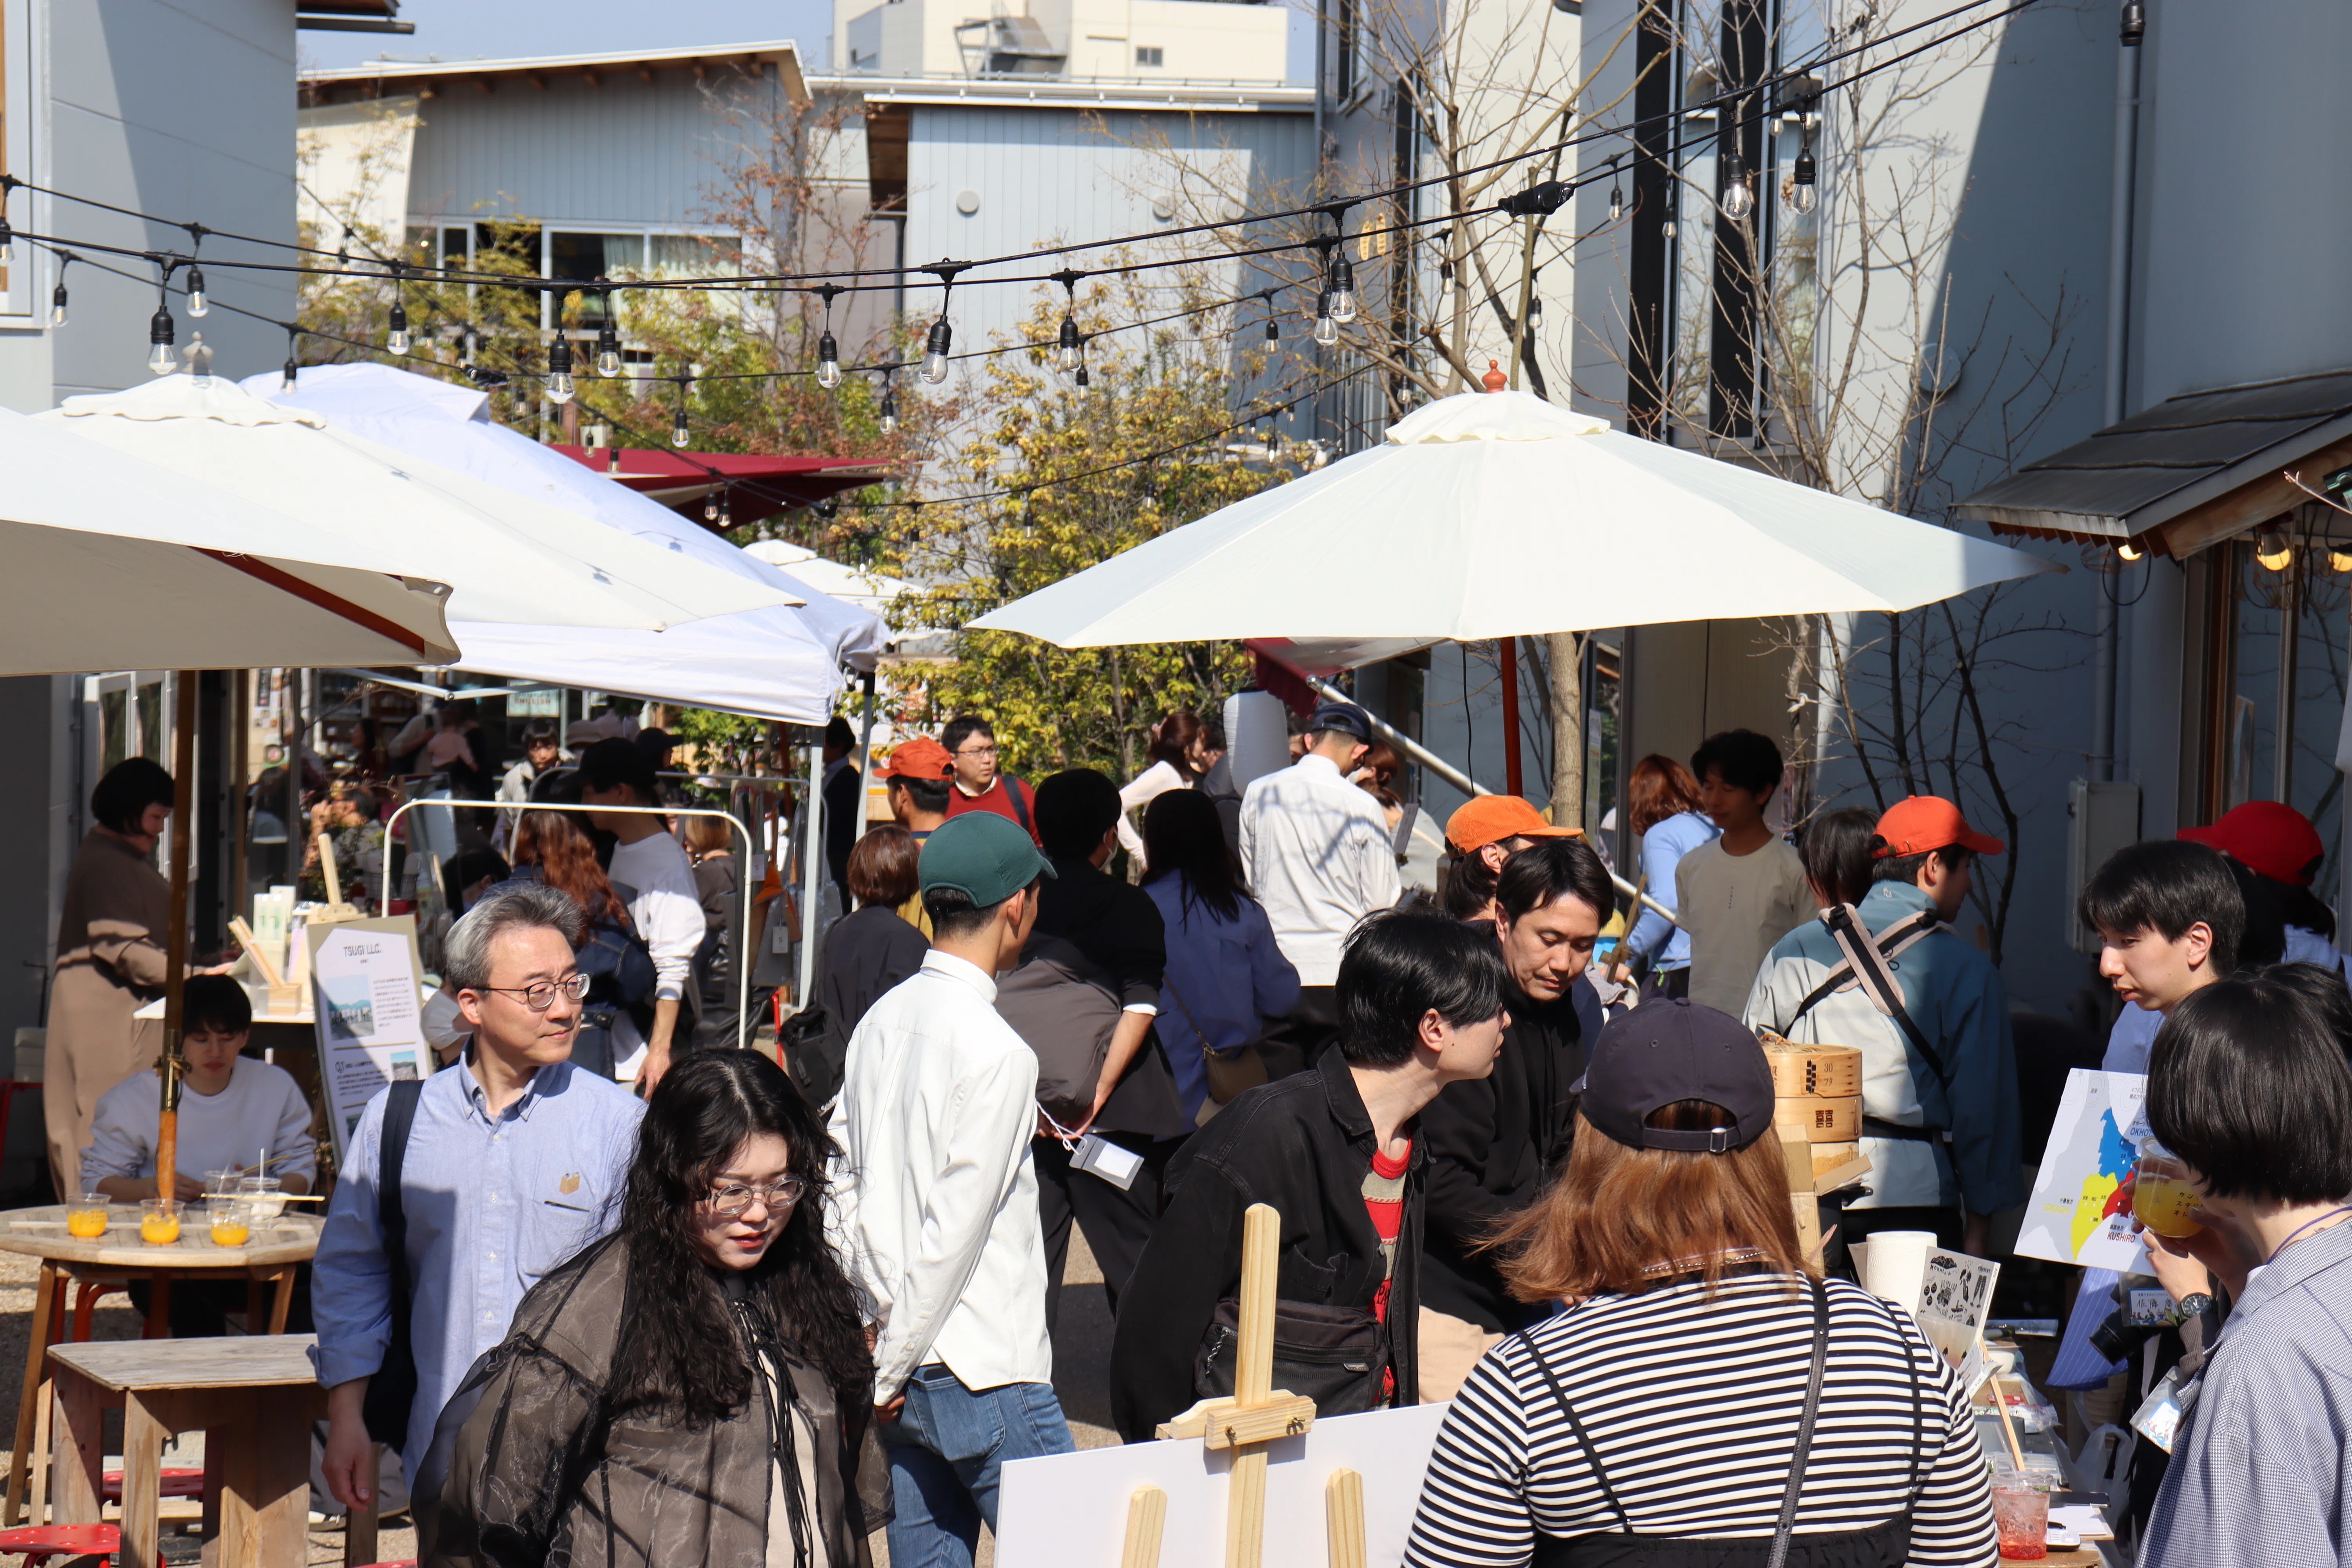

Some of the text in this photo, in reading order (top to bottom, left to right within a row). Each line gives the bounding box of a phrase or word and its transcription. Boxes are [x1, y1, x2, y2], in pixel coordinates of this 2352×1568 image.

[343, 943, 382, 957] TSUGI LLC.
[1824, 1063, 1833, 1072] 30
[2130, 1127, 2154, 1137] OKHOT
[2043, 1203, 2071, 1214] TOKACHI
[2107, 1231, 2136, 1243] KUSHIRO
[1930, 1264, 1951, 1276] Mountain
